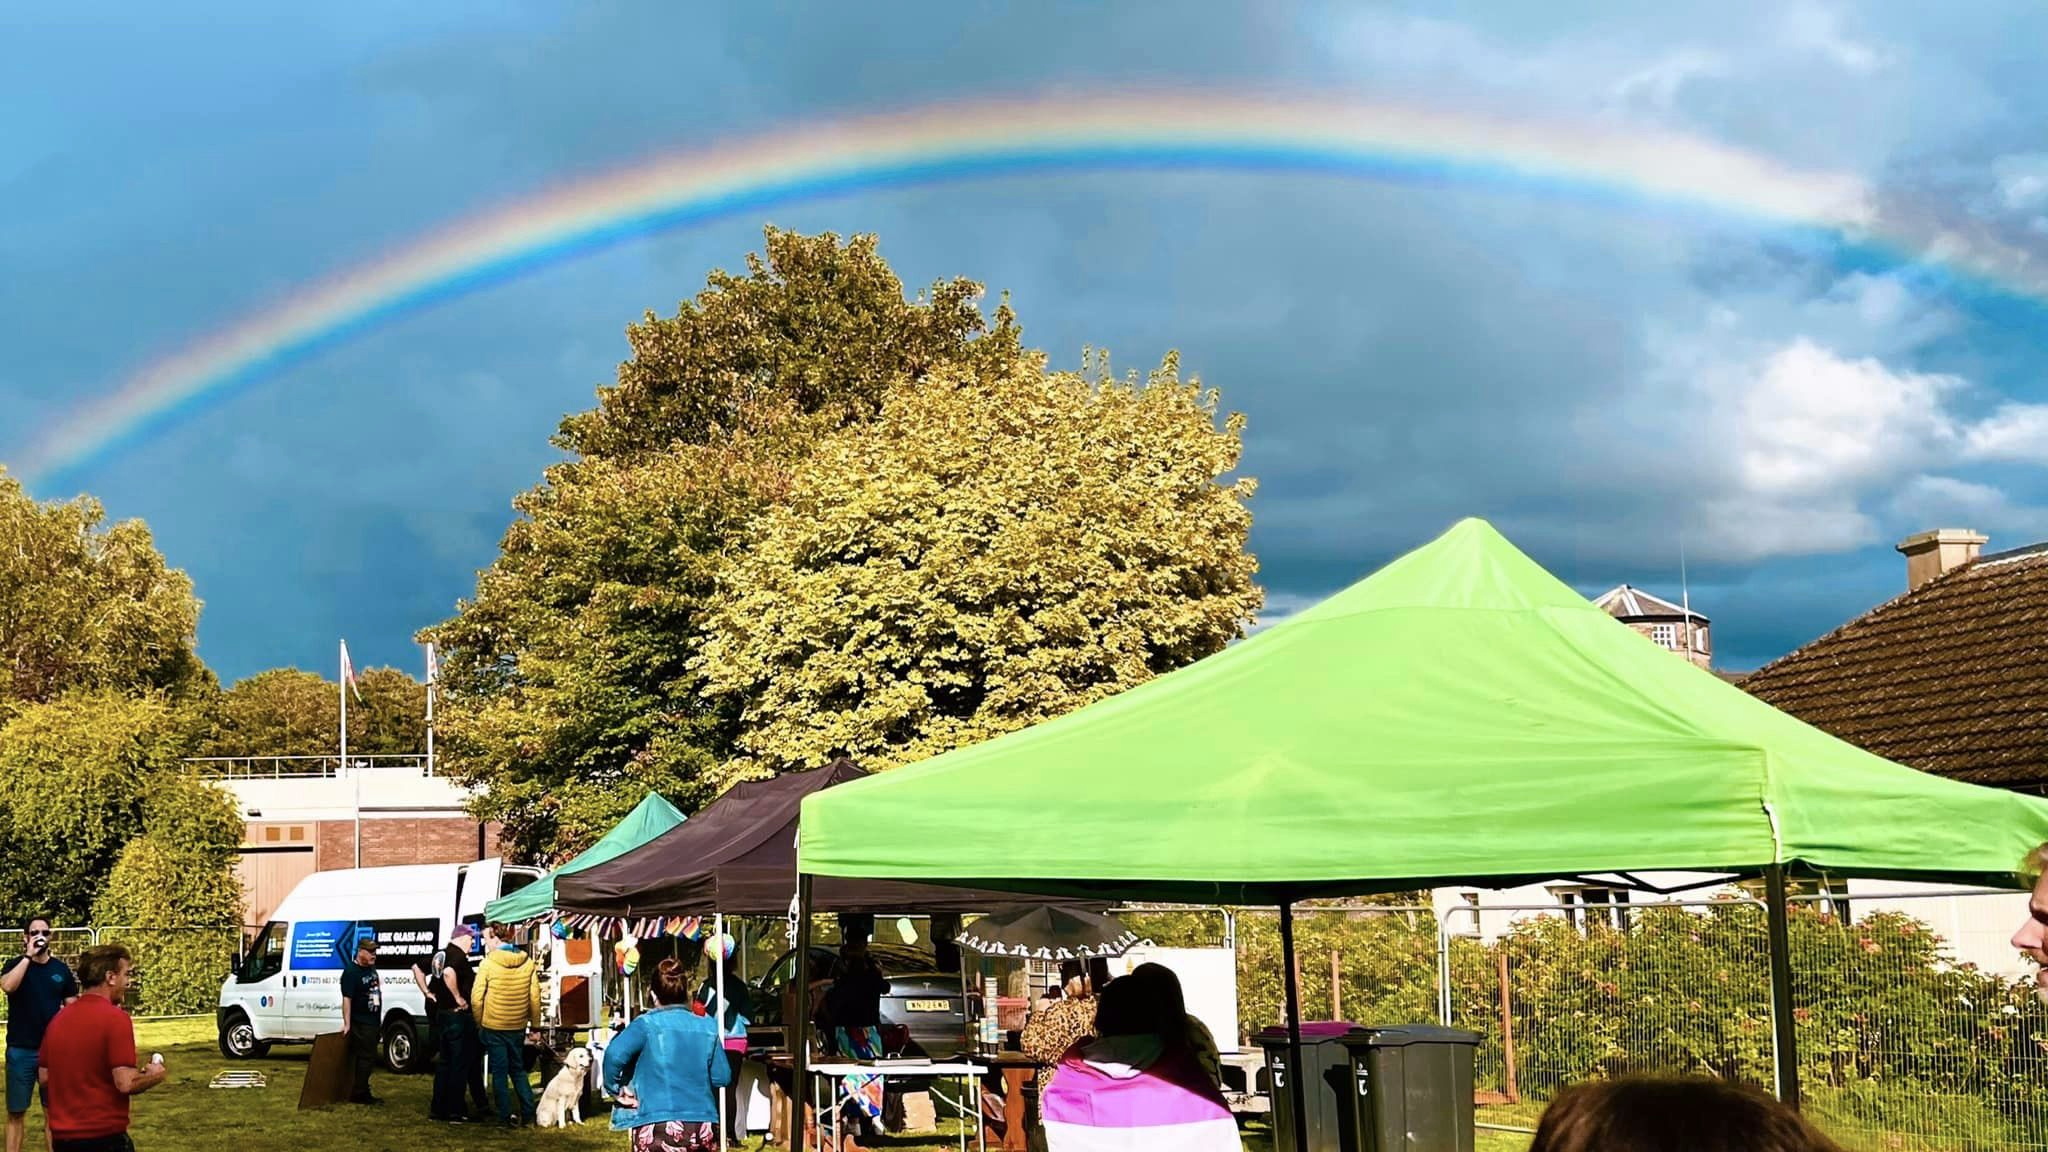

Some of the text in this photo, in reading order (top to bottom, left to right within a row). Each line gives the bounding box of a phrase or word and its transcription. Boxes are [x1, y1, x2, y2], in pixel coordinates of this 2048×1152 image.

[393, 932, 416, 942] GLASS
[416, 931, 434, 942] AND
[408, 945, 434, 955] REPAIR
